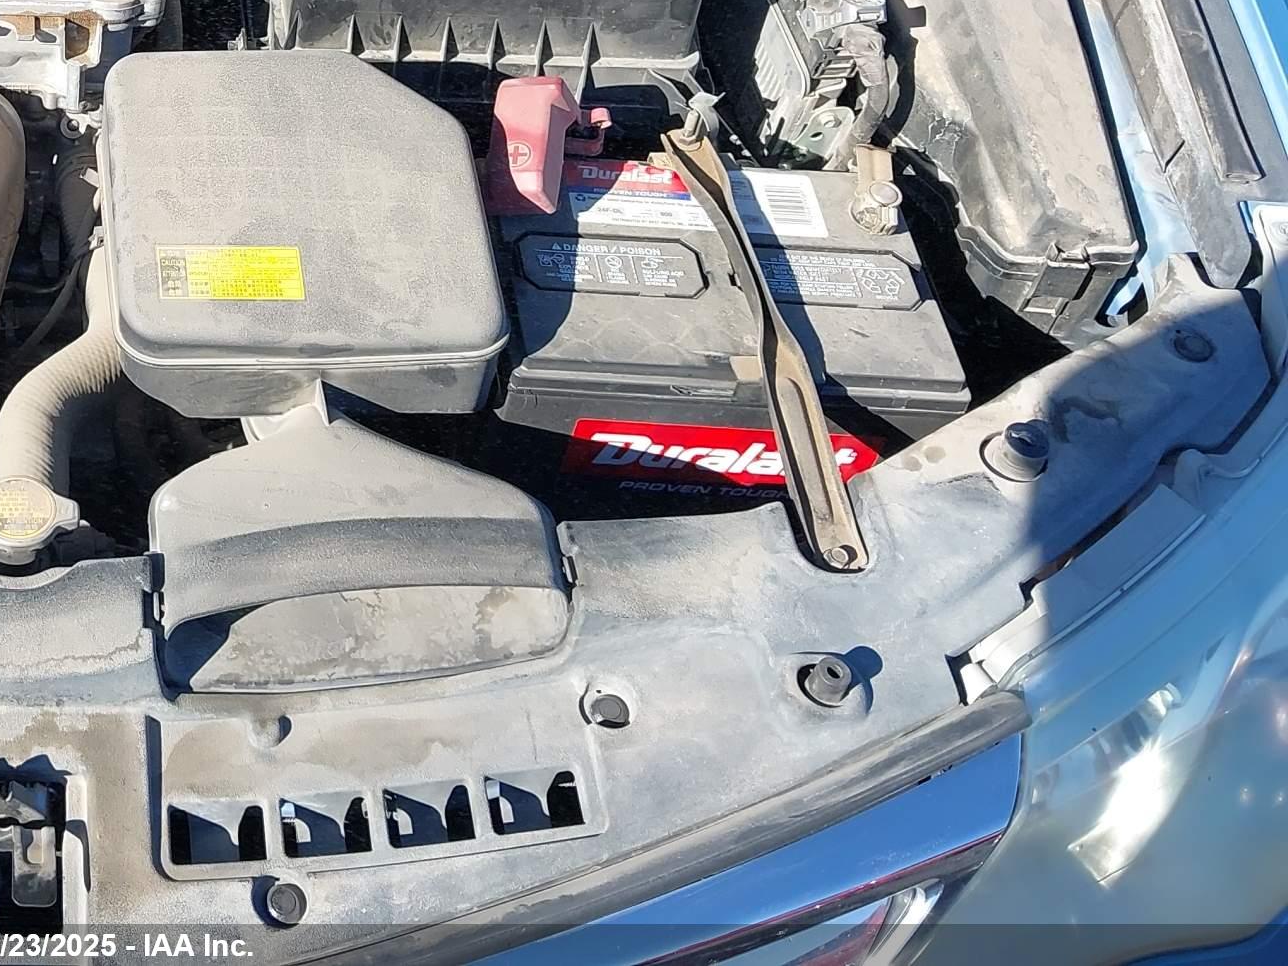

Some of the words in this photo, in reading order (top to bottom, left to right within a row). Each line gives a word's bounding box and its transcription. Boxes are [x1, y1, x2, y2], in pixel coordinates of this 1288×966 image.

[577, 165, 673, 184] Duralast
[563, 242, 608, 254] DANGER
[620, 245, 662, 256] POISON
[618, 480, 712, 495] PROVEN
